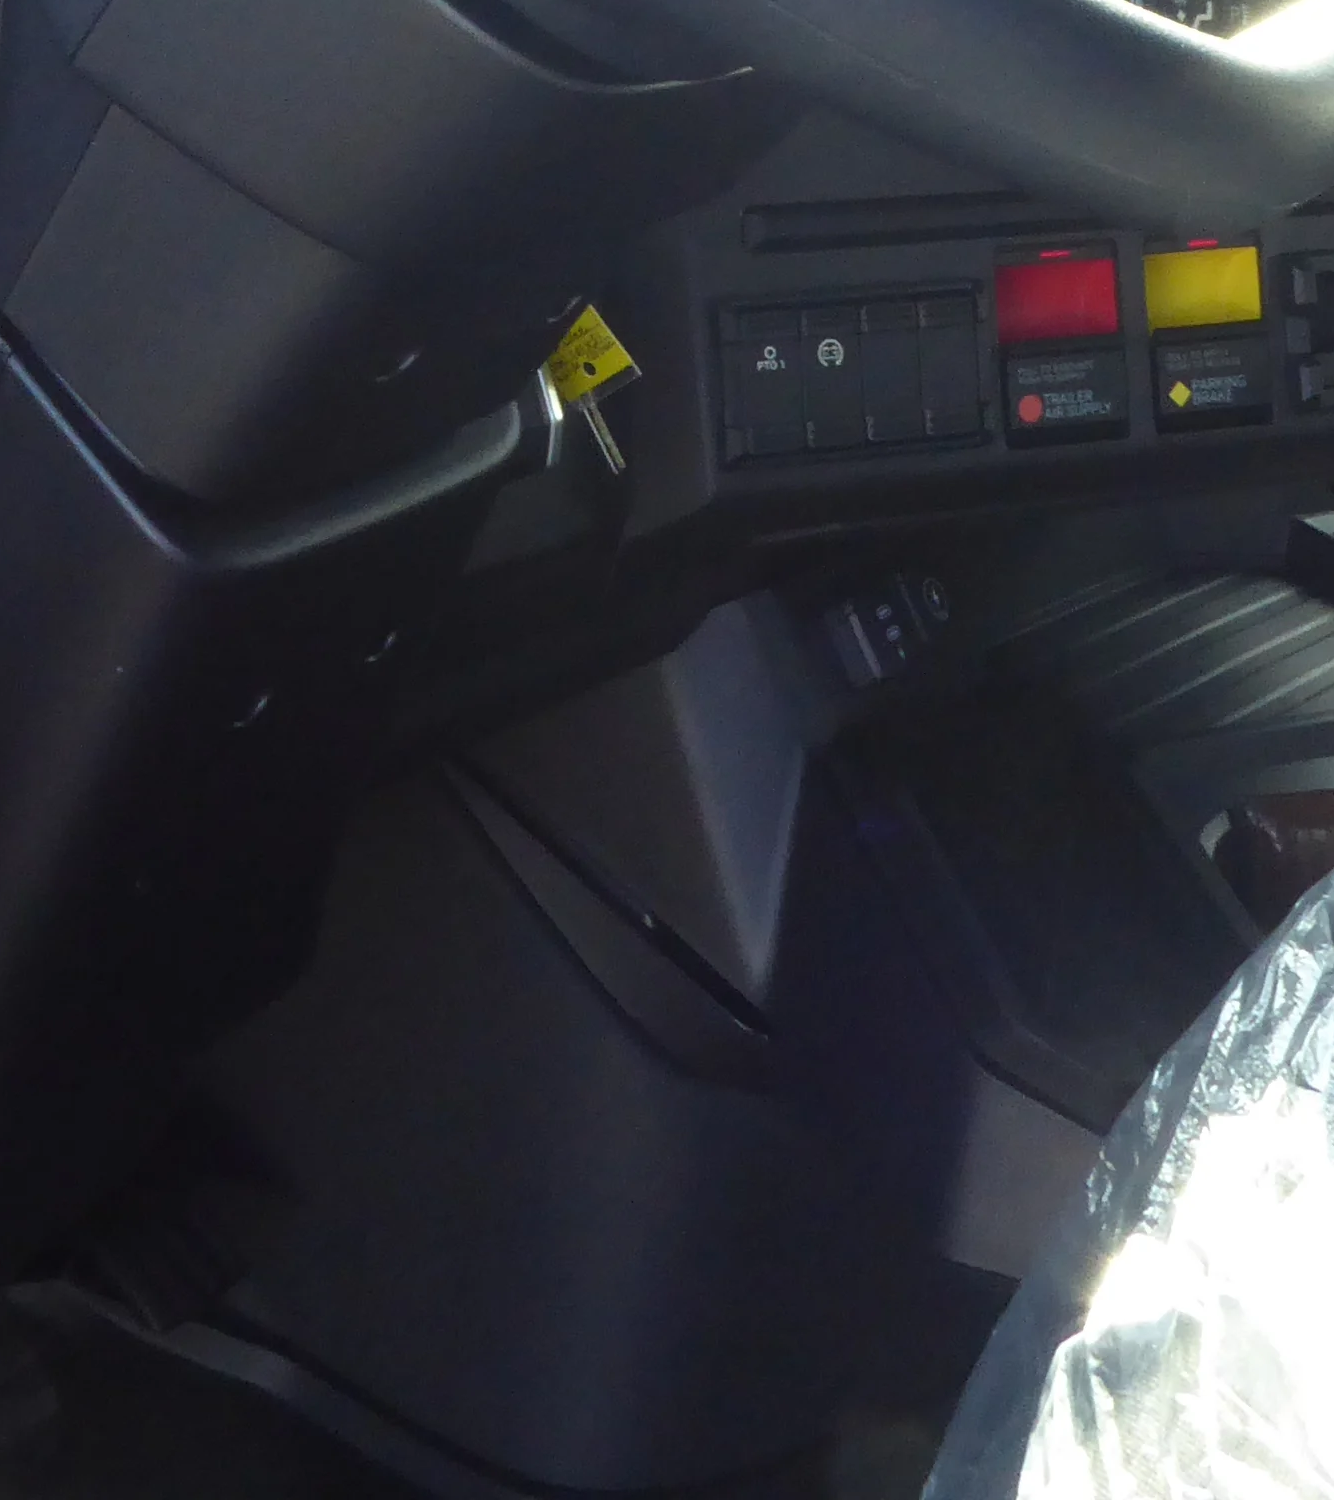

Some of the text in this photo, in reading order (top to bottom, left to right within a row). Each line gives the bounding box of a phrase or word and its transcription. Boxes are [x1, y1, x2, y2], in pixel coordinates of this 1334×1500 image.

[756, 360, 778, 371] PTO
[1192, 374, 1247, 391] PARKING
[1043, 390, 1093, 404] TRAILER
[1193, 388, 1232, 405] BRAKE
[1046, 402, 1111, 418] AIR SUPPLY
